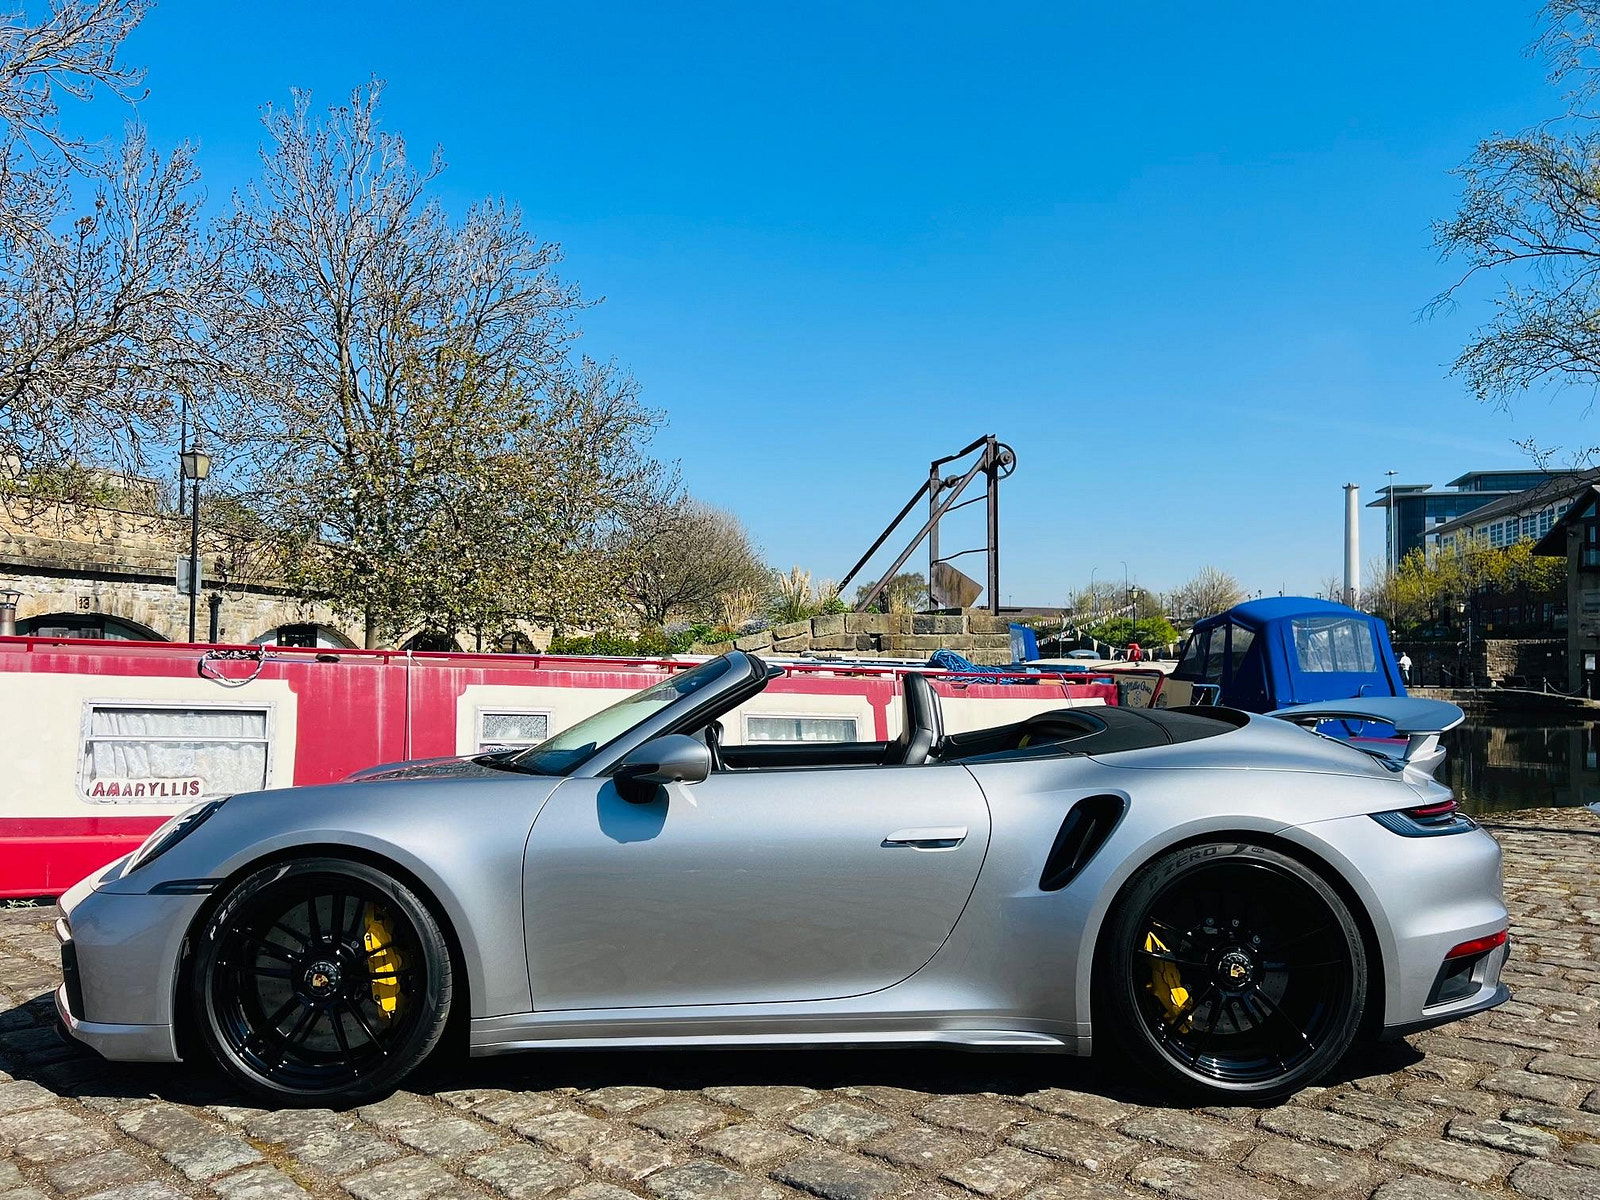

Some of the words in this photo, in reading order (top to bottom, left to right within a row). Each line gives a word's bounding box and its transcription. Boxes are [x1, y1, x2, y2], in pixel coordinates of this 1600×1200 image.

[79, 598, 90, 609] 13
[92, 780, 200, 797] AMARYLLIS
[1163, 847, 1217, 877] ZERO
